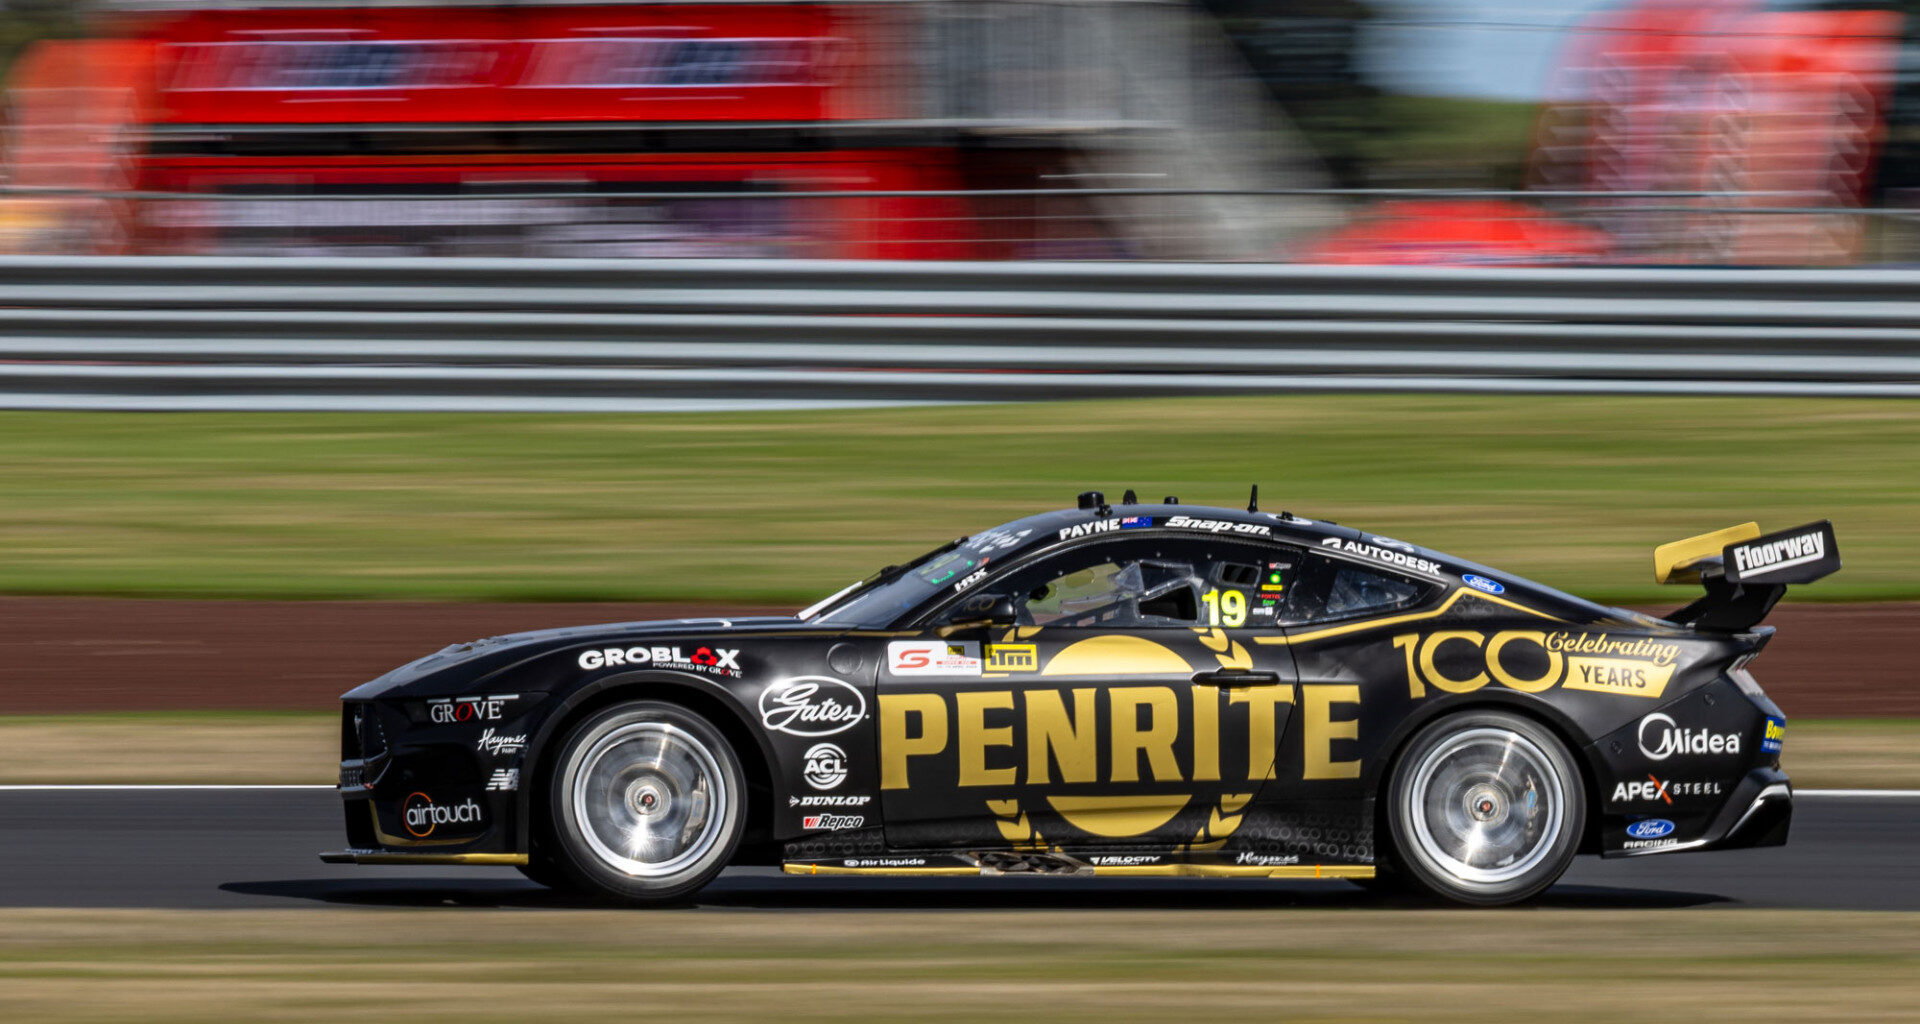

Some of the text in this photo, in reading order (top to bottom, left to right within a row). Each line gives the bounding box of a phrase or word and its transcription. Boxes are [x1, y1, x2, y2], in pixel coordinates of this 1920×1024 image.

[1059, 518, 1121, 541] PAYNE
[1165, 515, 1270, 536] Snap-on
[1343, 541, 1442, 576] AUTODESK
[1734, 531, 1825, 576] Floorway
[1201, 589, 1246, 628] 19
[1545, 632, 1682, 666] Celebrating
[652, 662, 742, 679] POWERED BY GROVE
[1579, 665, 1647, 688] YEARS
[430, 701, 503, 723] GROVE
[763, 683, 855, 730] Gates
[477, 727, 527, 756] Haymes
[877, 684, 1362, 790] PENRITE
[1655, 726, 1742, 756] Midea
[804, 758, 848, 774] ACL
[1611, 774, 1722, 805] APEX STEEL
[405, 798, 481, 827] airtouch
[799, 796, 871, 807] DUNLOP
[817, 813, 864, 830] Repco
[1634, 821, 1667, 836] Ford
[1623, 838, 1678, 849] RACING
[860, 857, 926, 868] Air Liquide
[1101, 855, 1161, 865] VELOCITY
